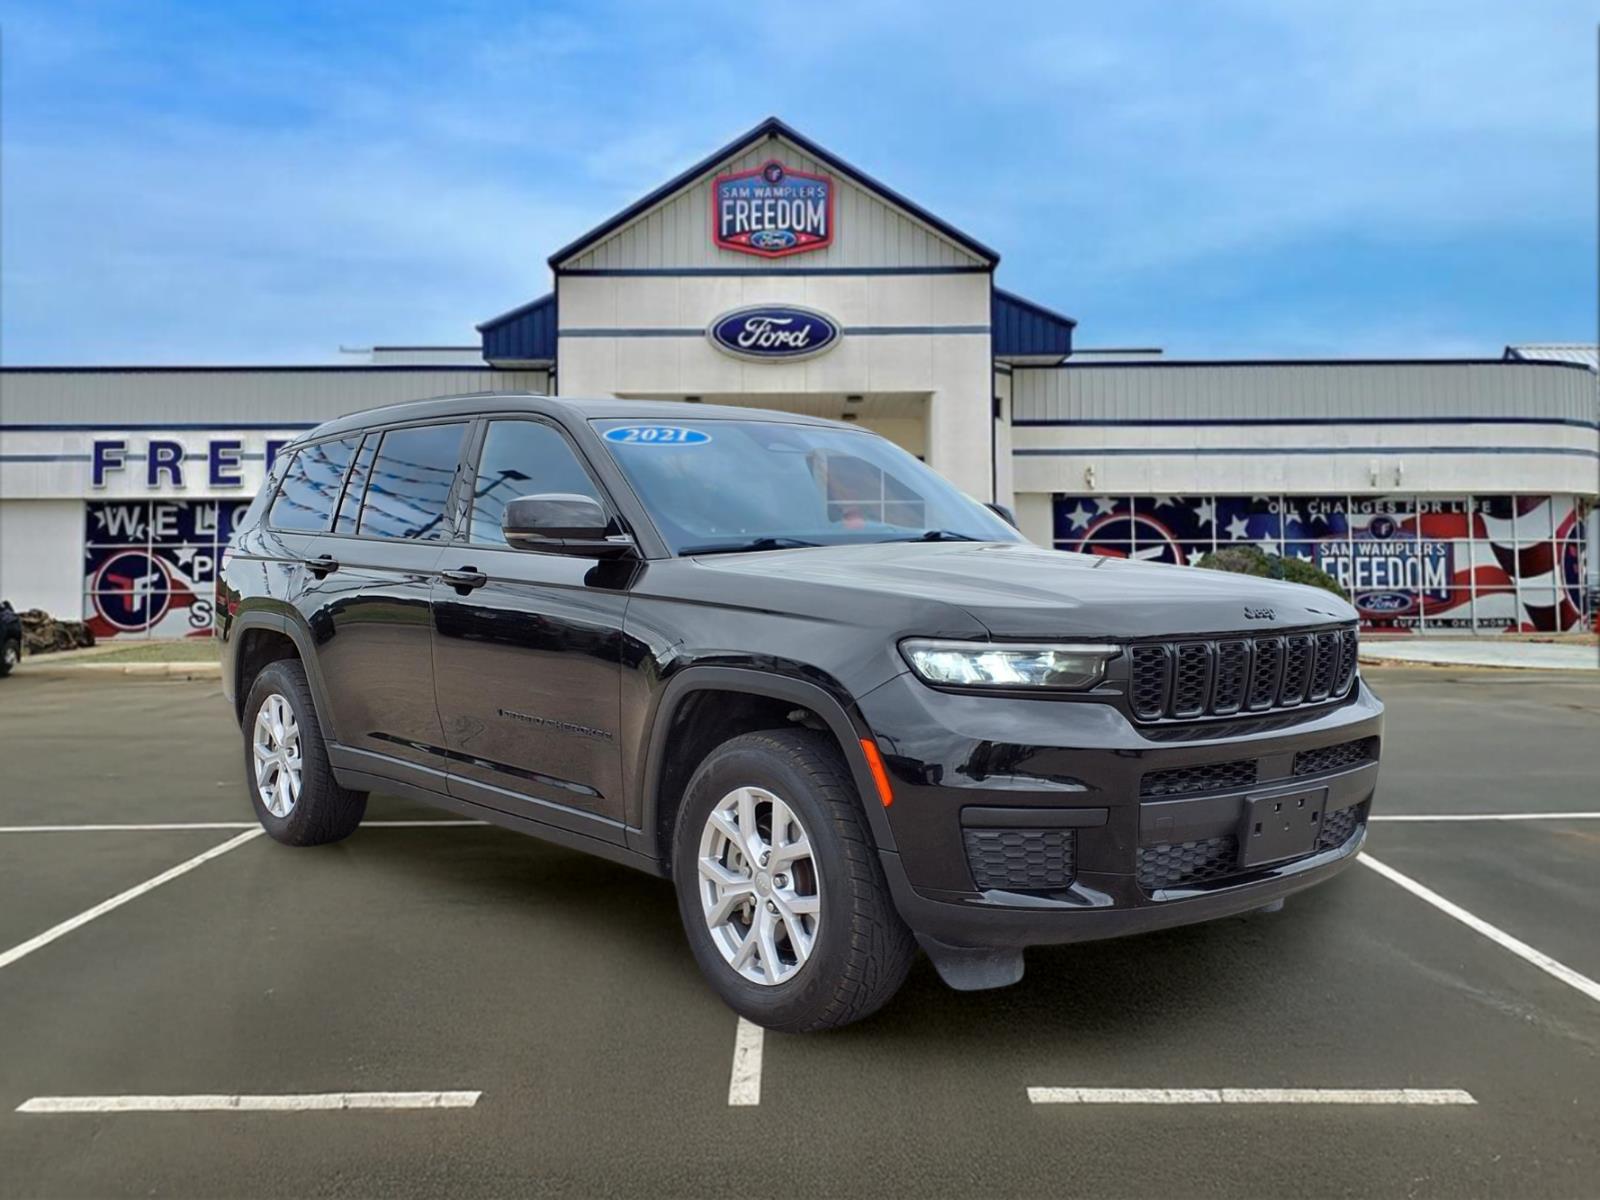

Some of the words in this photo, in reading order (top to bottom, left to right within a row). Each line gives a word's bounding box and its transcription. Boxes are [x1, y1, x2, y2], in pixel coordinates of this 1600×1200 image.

[722, 187, 750, 198] SAM
[722, 199, 826, 236] FREEDOM
[738, 317, 811, 348] Ford
[624, 429, 688, 441] 2021
[1268, 502, 1299, 514] OIL
[1308, 501, 1397, 514] CHANGES
[1406, 501, 1442, 513] FOR
[1321, 556, 1447, 598] FREEDOM
[1365, 595, 1400, 609] Ford
[1244, 606, 1276, 621] Jeep
